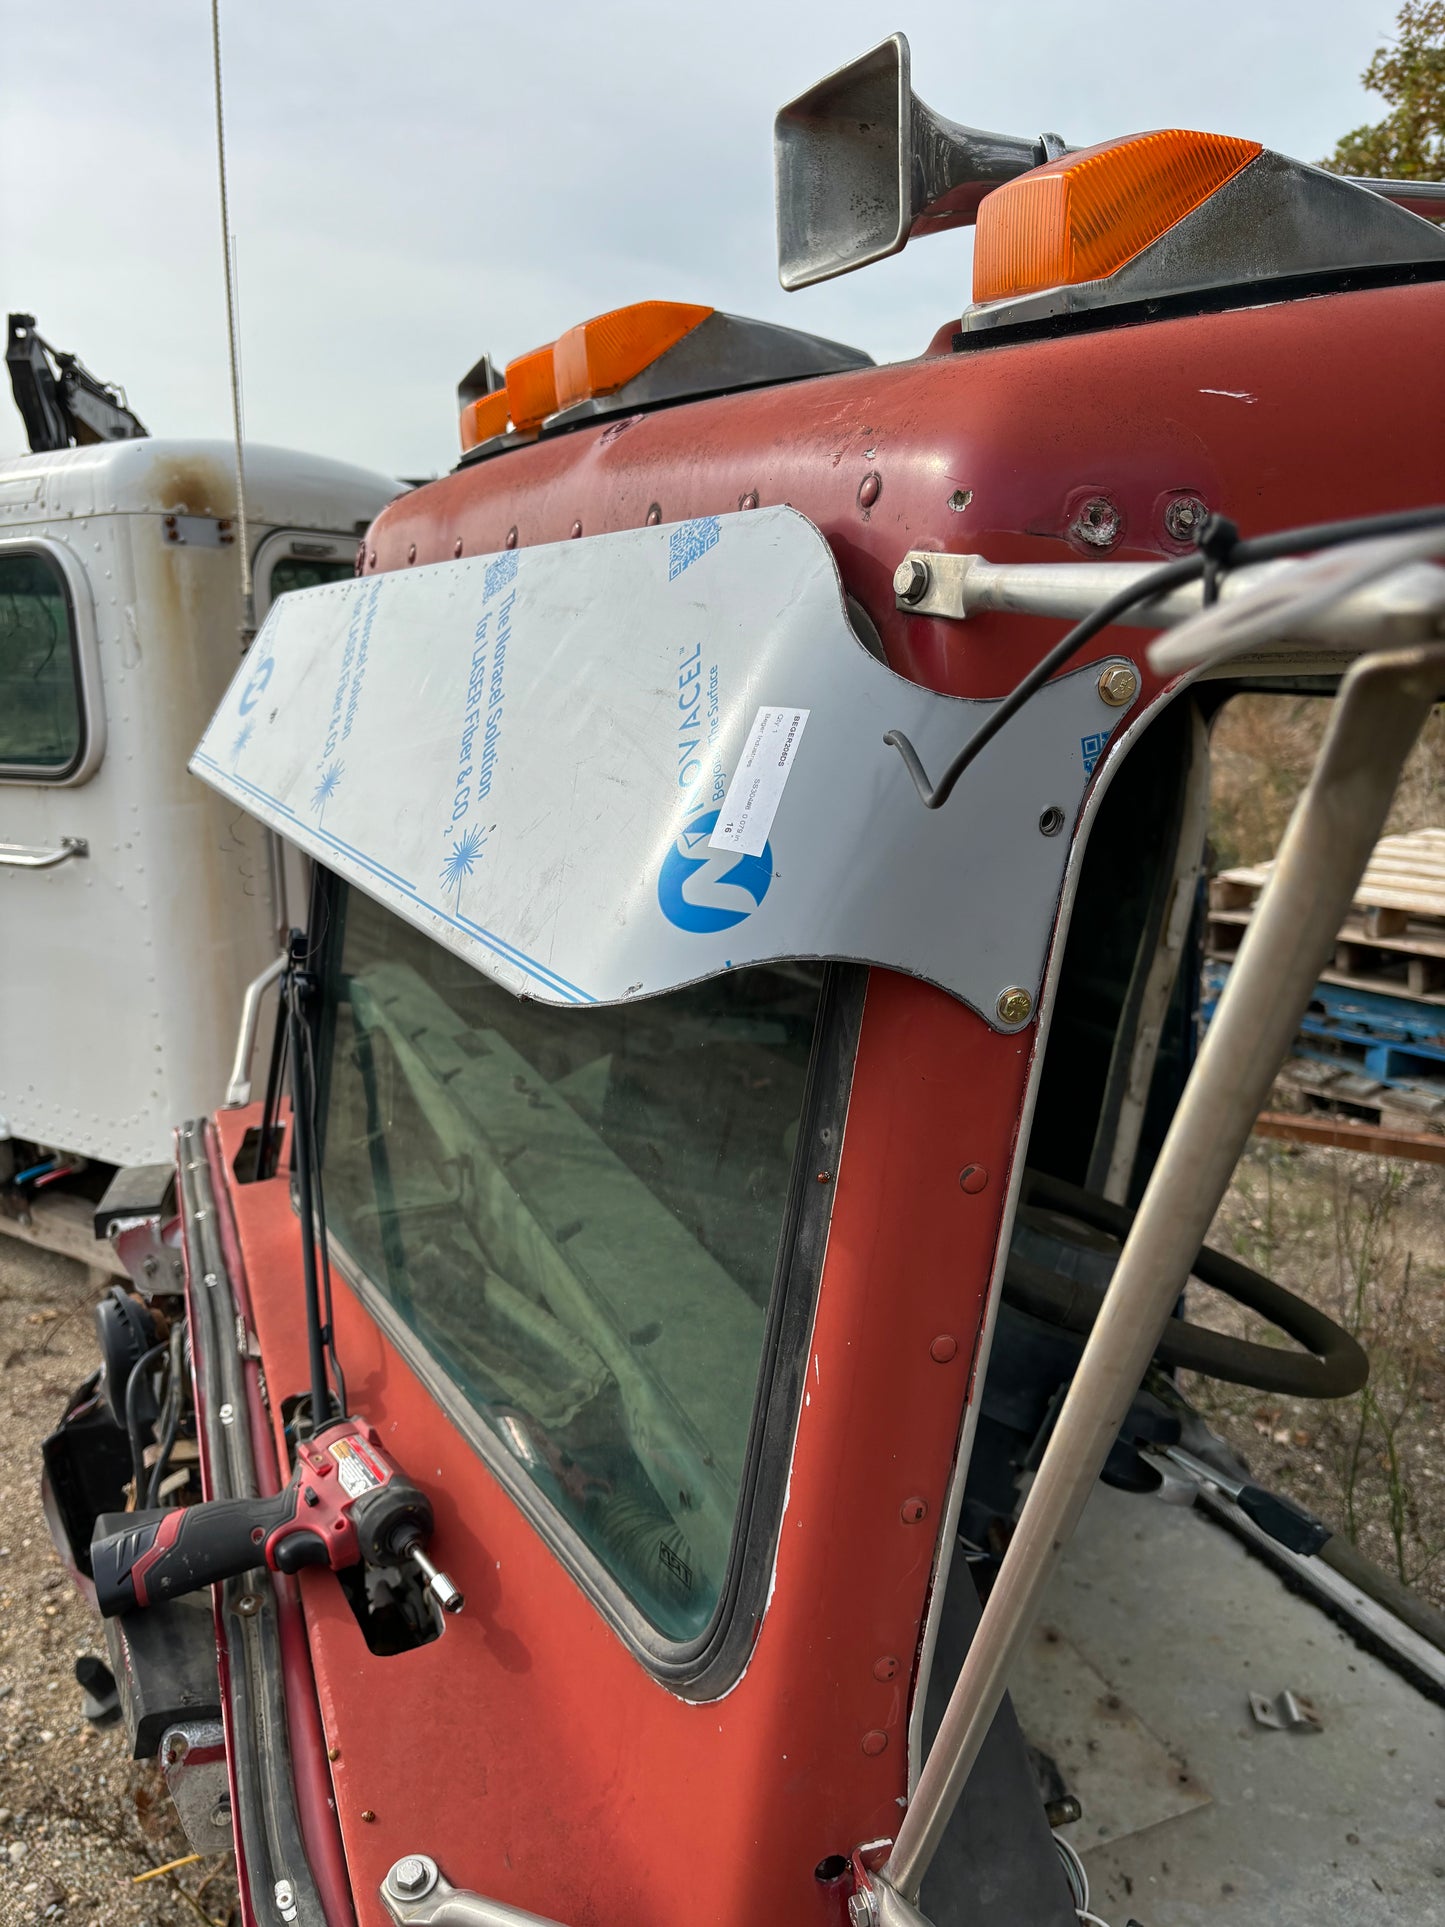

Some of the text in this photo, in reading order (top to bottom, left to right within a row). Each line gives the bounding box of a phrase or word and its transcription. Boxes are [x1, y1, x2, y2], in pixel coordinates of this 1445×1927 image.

[474, 612, 493, 643] for
[332, 670, 350, 714] Fiber
[342, 667, 364, 741] Solution
[466, 641, 488, 711] LASER
[478, 588, 516, 801] The Novacel Solution
[459, 708, 480, 764] Fiber
[707, 664, 727, 802] Beyo The Surface
[456, 765, 473, 789] &
[724, 822, 734, 834] 16
